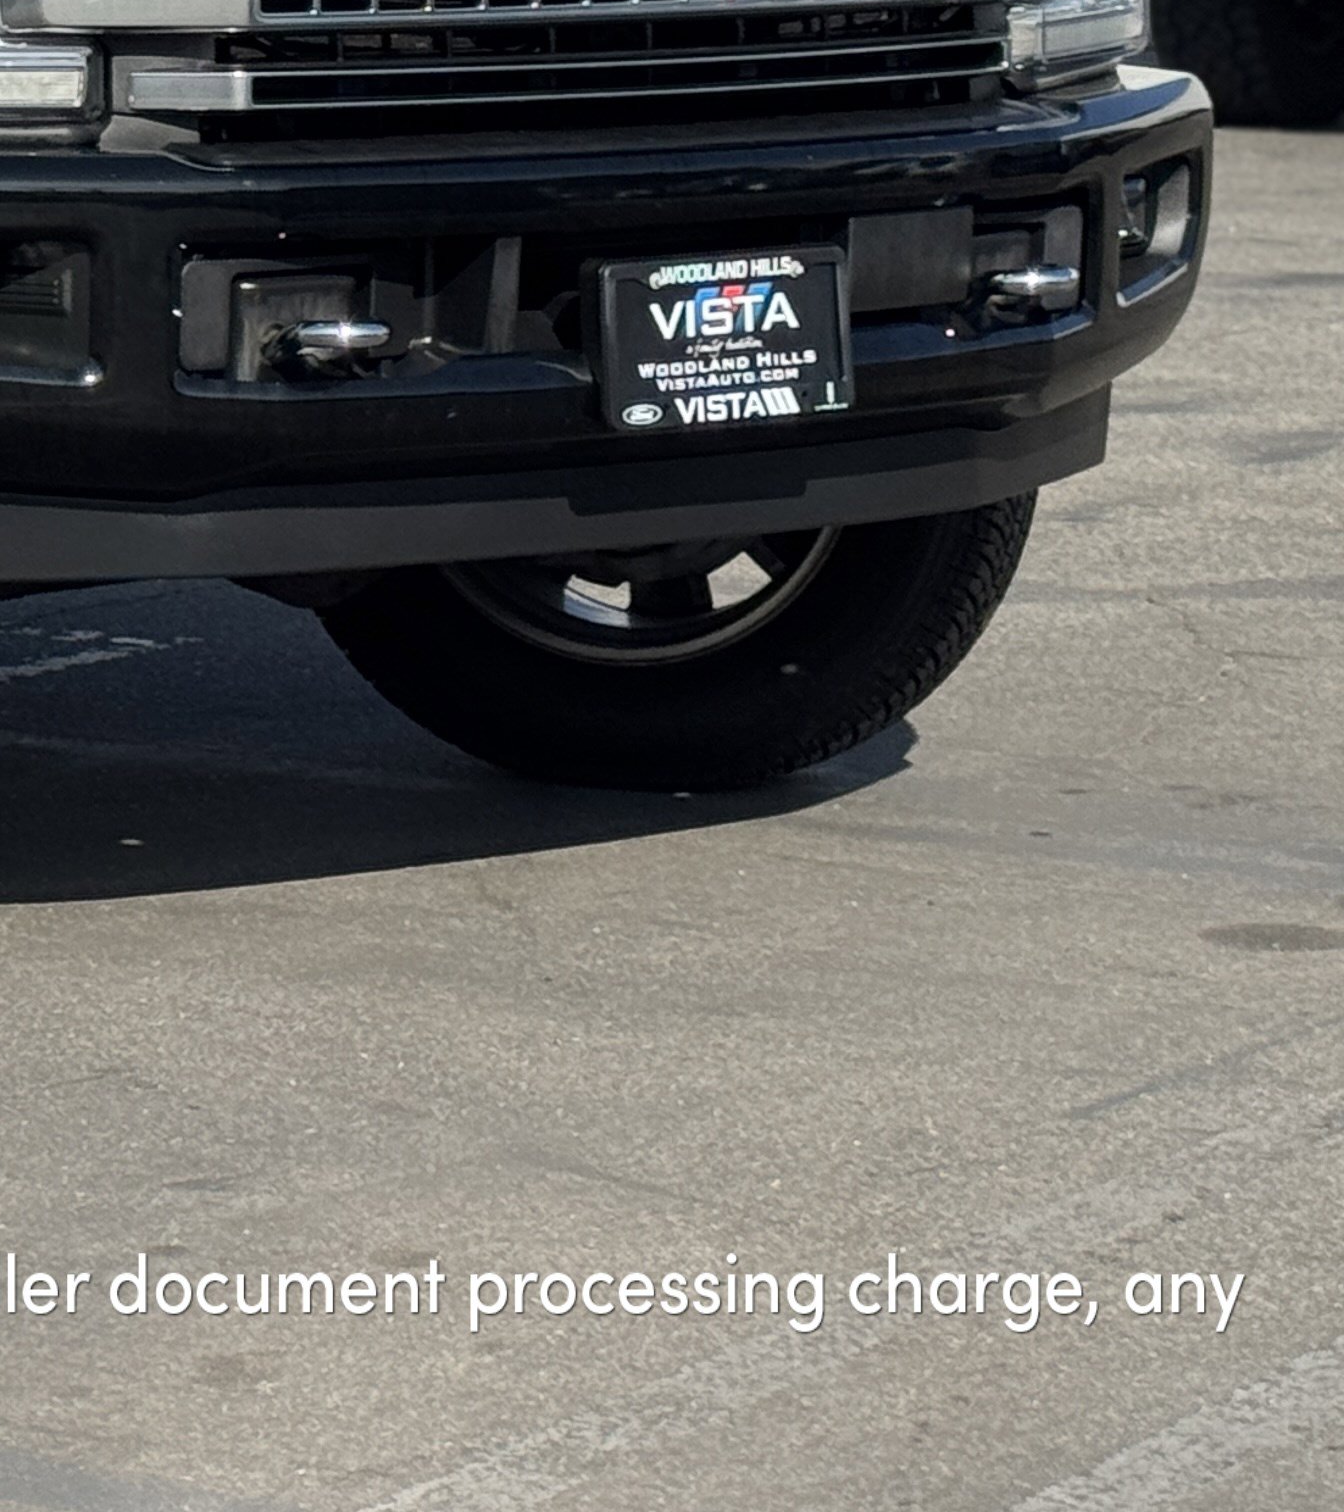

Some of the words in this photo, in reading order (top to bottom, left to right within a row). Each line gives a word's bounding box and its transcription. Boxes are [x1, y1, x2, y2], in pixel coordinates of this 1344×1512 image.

[659, 259, 749, 284] WOODLAND
[750, 255, 793, 278] HILLS
[648, 291, 801, 340] VISTA
[637, 354, 750, 380] WOODLAND
[756, 349, 818, 369] HILLS
[673, 390, 768, 425] VISTA
